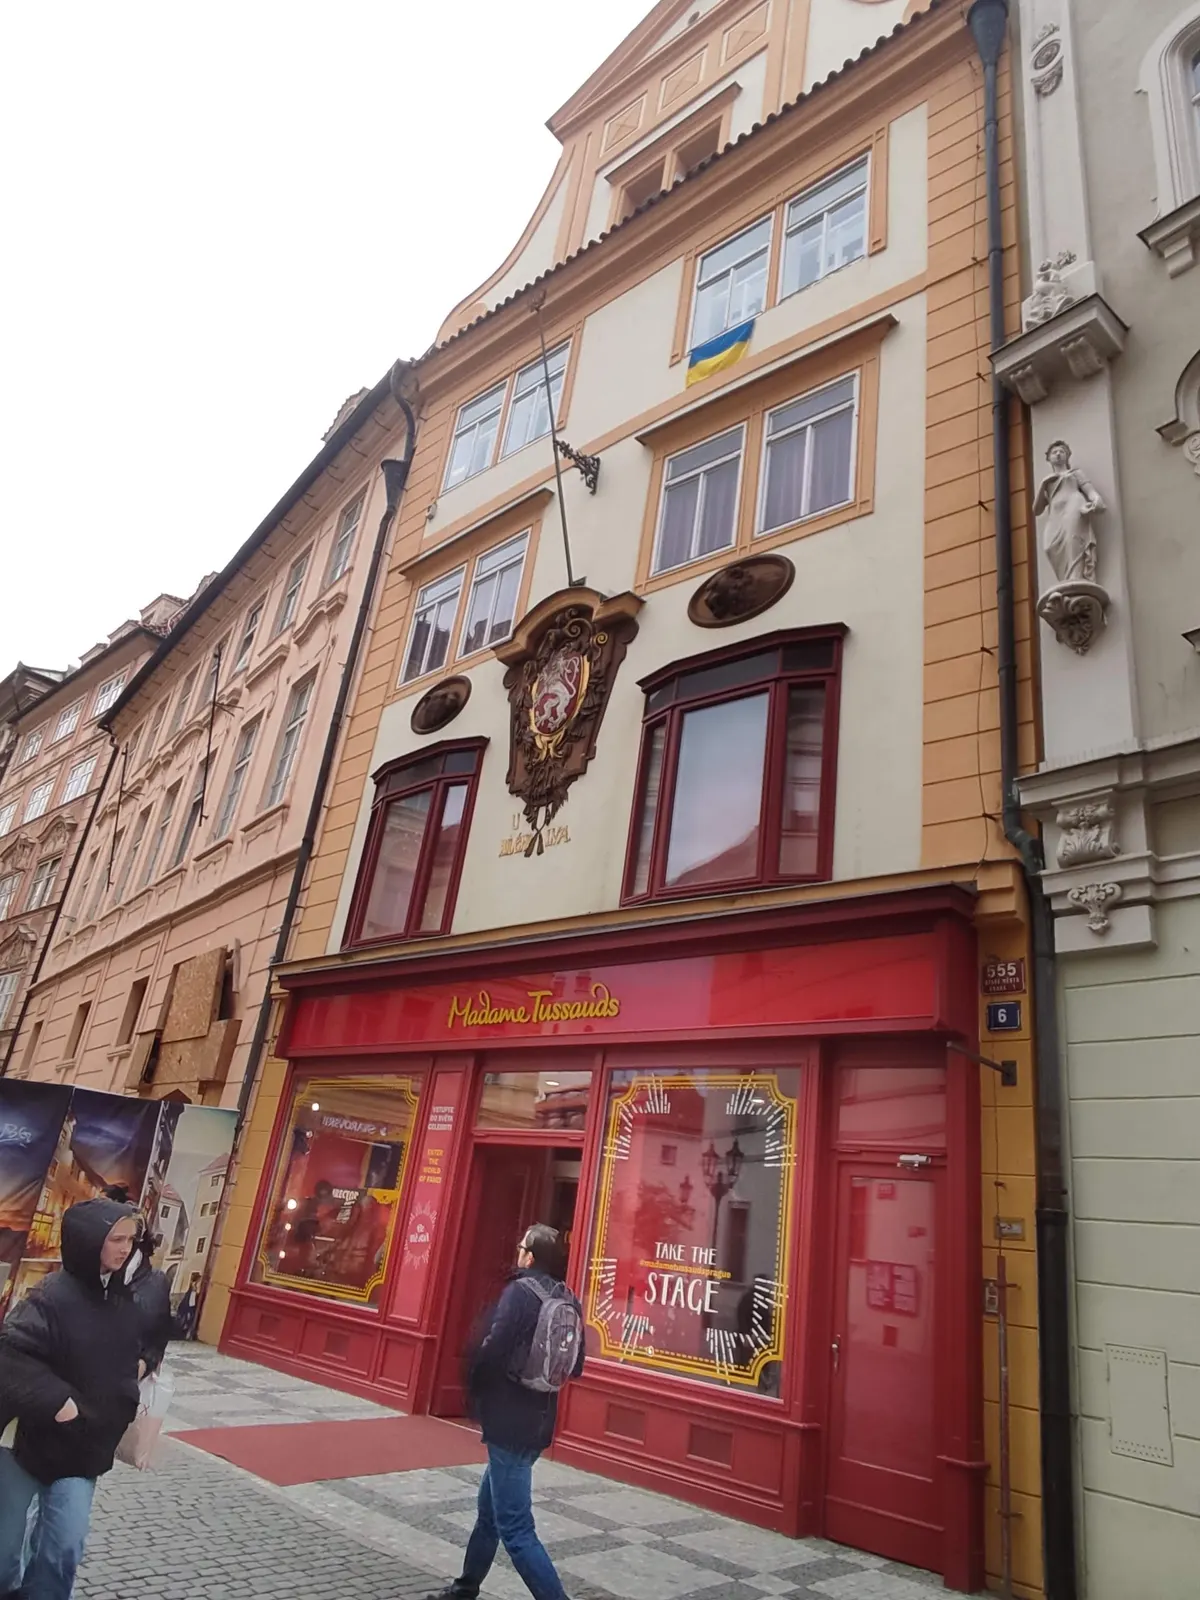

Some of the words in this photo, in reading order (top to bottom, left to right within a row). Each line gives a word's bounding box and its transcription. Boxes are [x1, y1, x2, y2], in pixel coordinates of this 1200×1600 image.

[987, 963, 1017, 978] 555
[447, 990, 531, 1028] Madame
[528, 983, 621, 1023] Tussauds
[998, 1008, 1007, 1023] 6
[654, 1241, 686, 1261] TAKE
[691, 1246, 717, 1265] THE
[644, 1272, 720, 1316] STAGE
